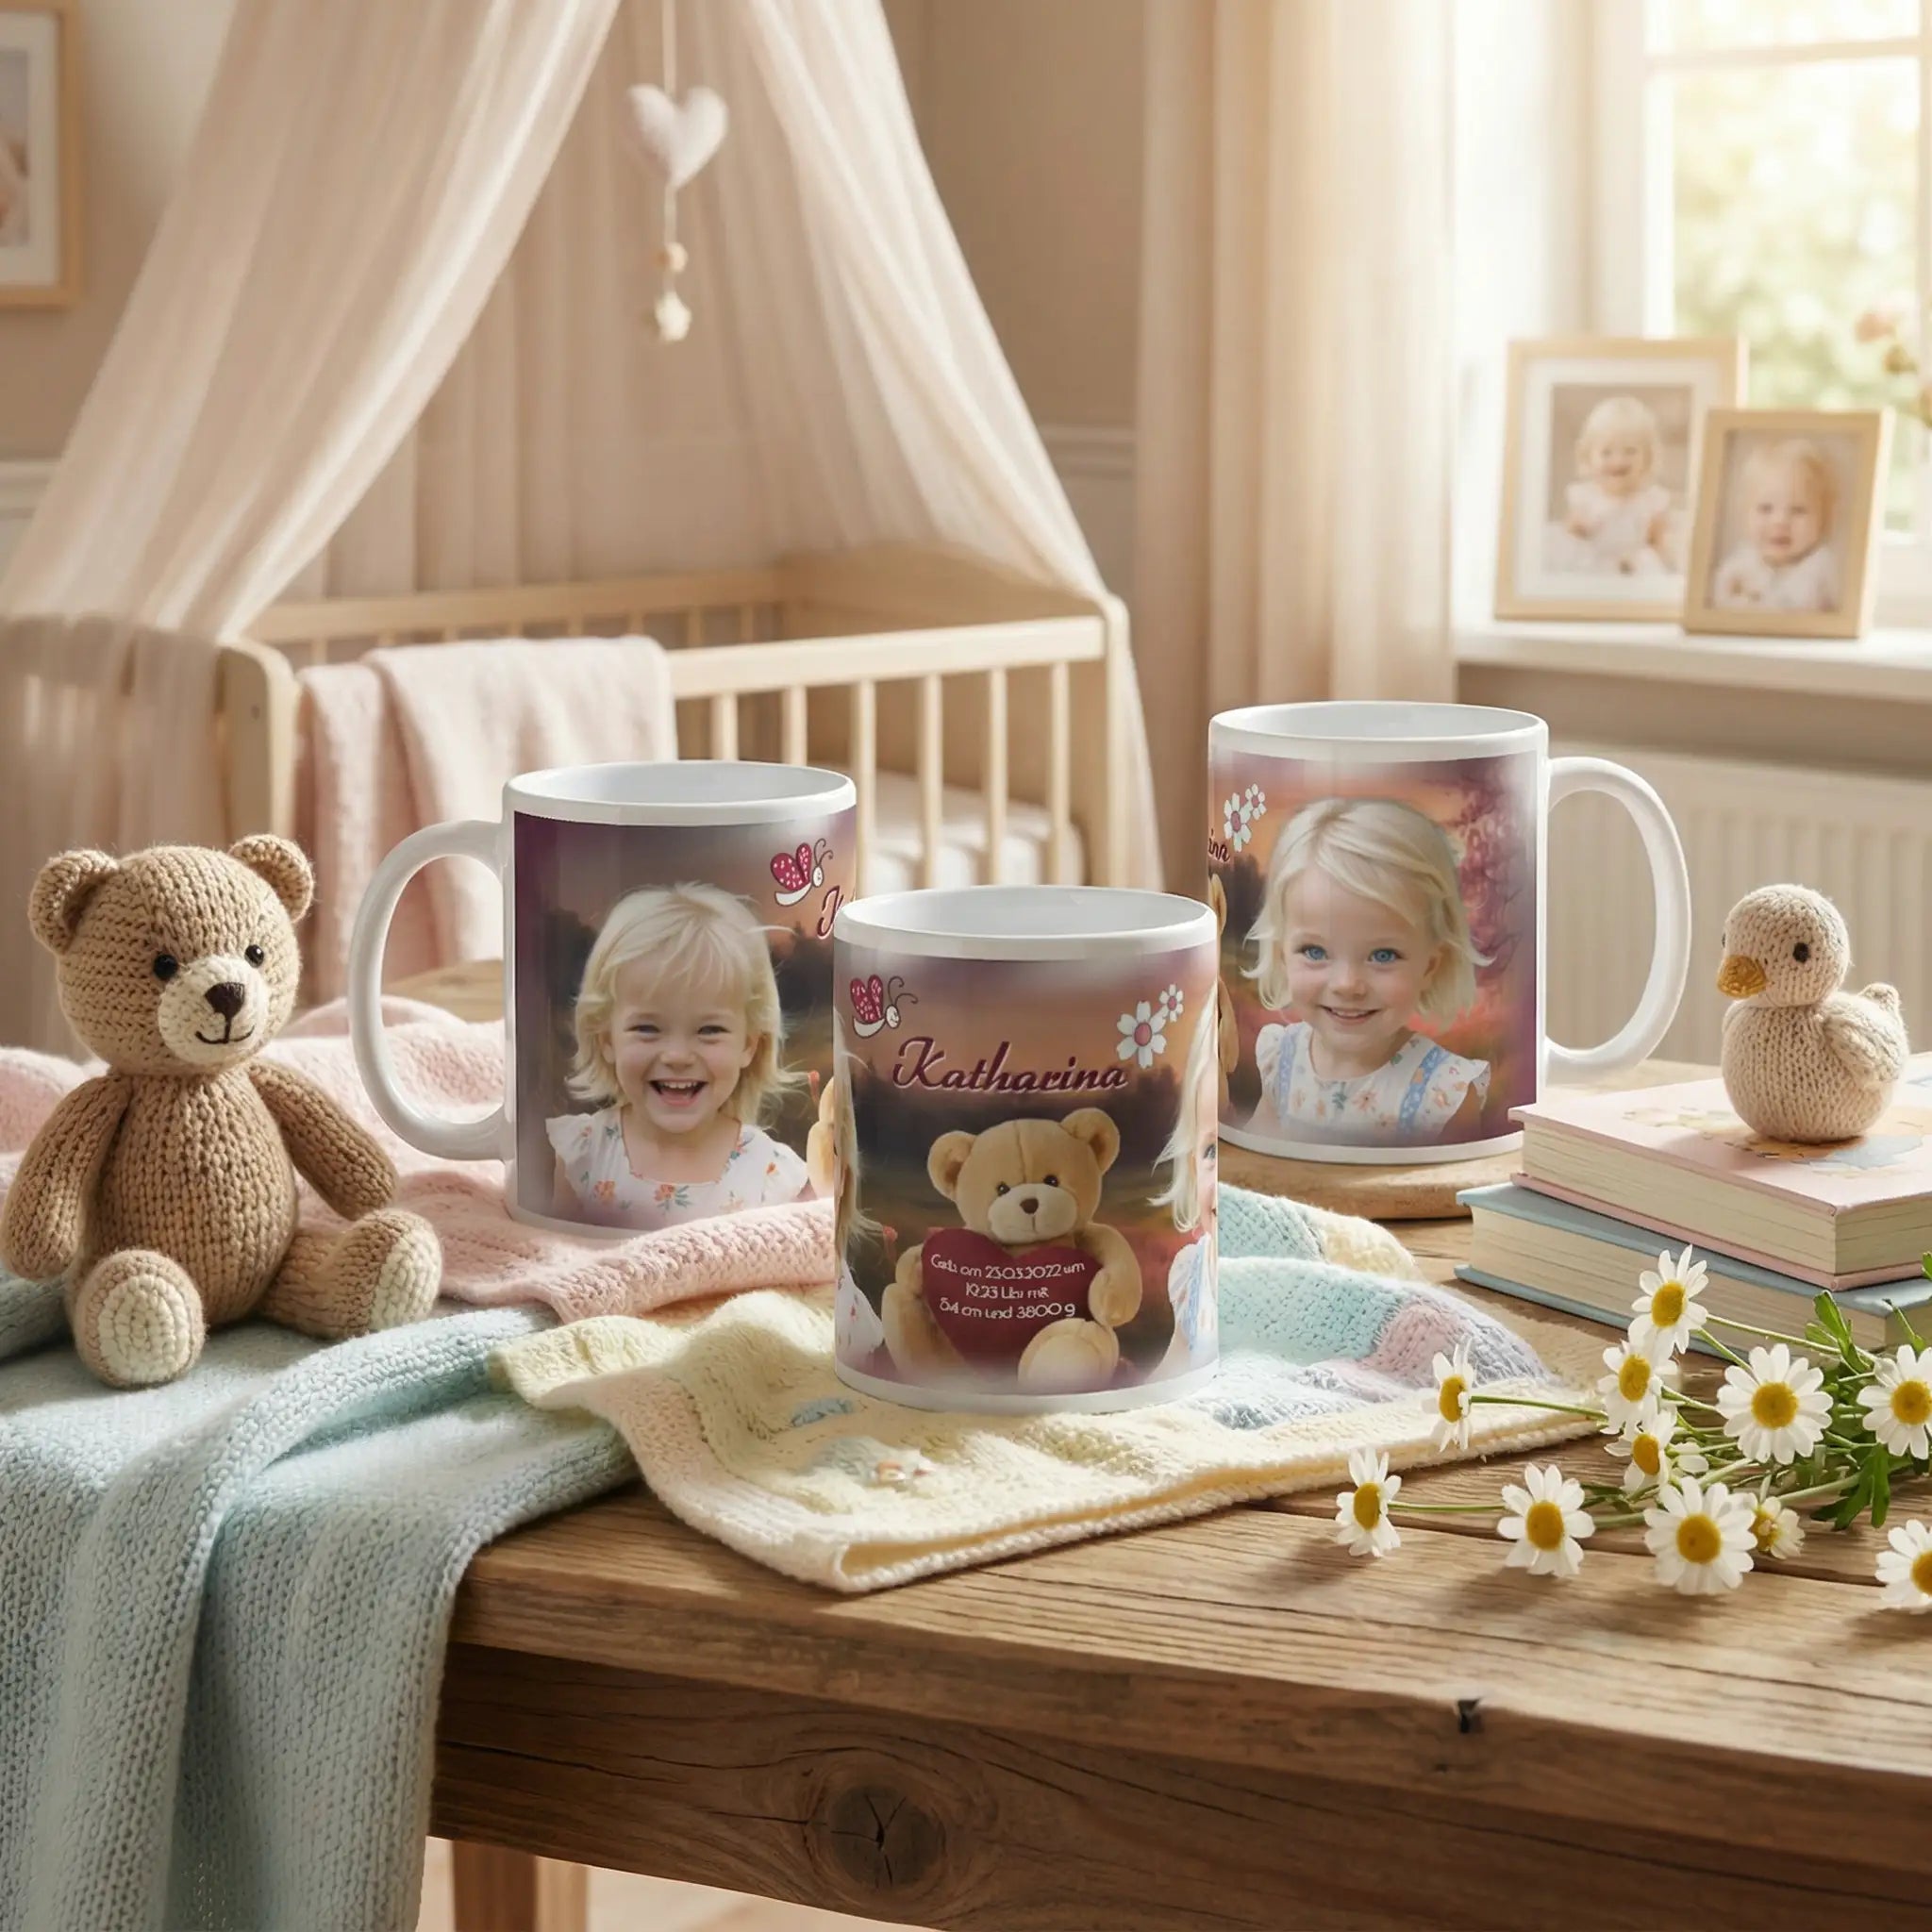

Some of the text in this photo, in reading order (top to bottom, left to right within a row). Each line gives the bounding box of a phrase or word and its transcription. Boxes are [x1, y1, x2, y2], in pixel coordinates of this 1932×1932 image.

[892, 1036, 1128, 1092] Katharina
[1016, 1302, 1062, 1319] 3800
[1064, 1303, 1075, 1318] g
